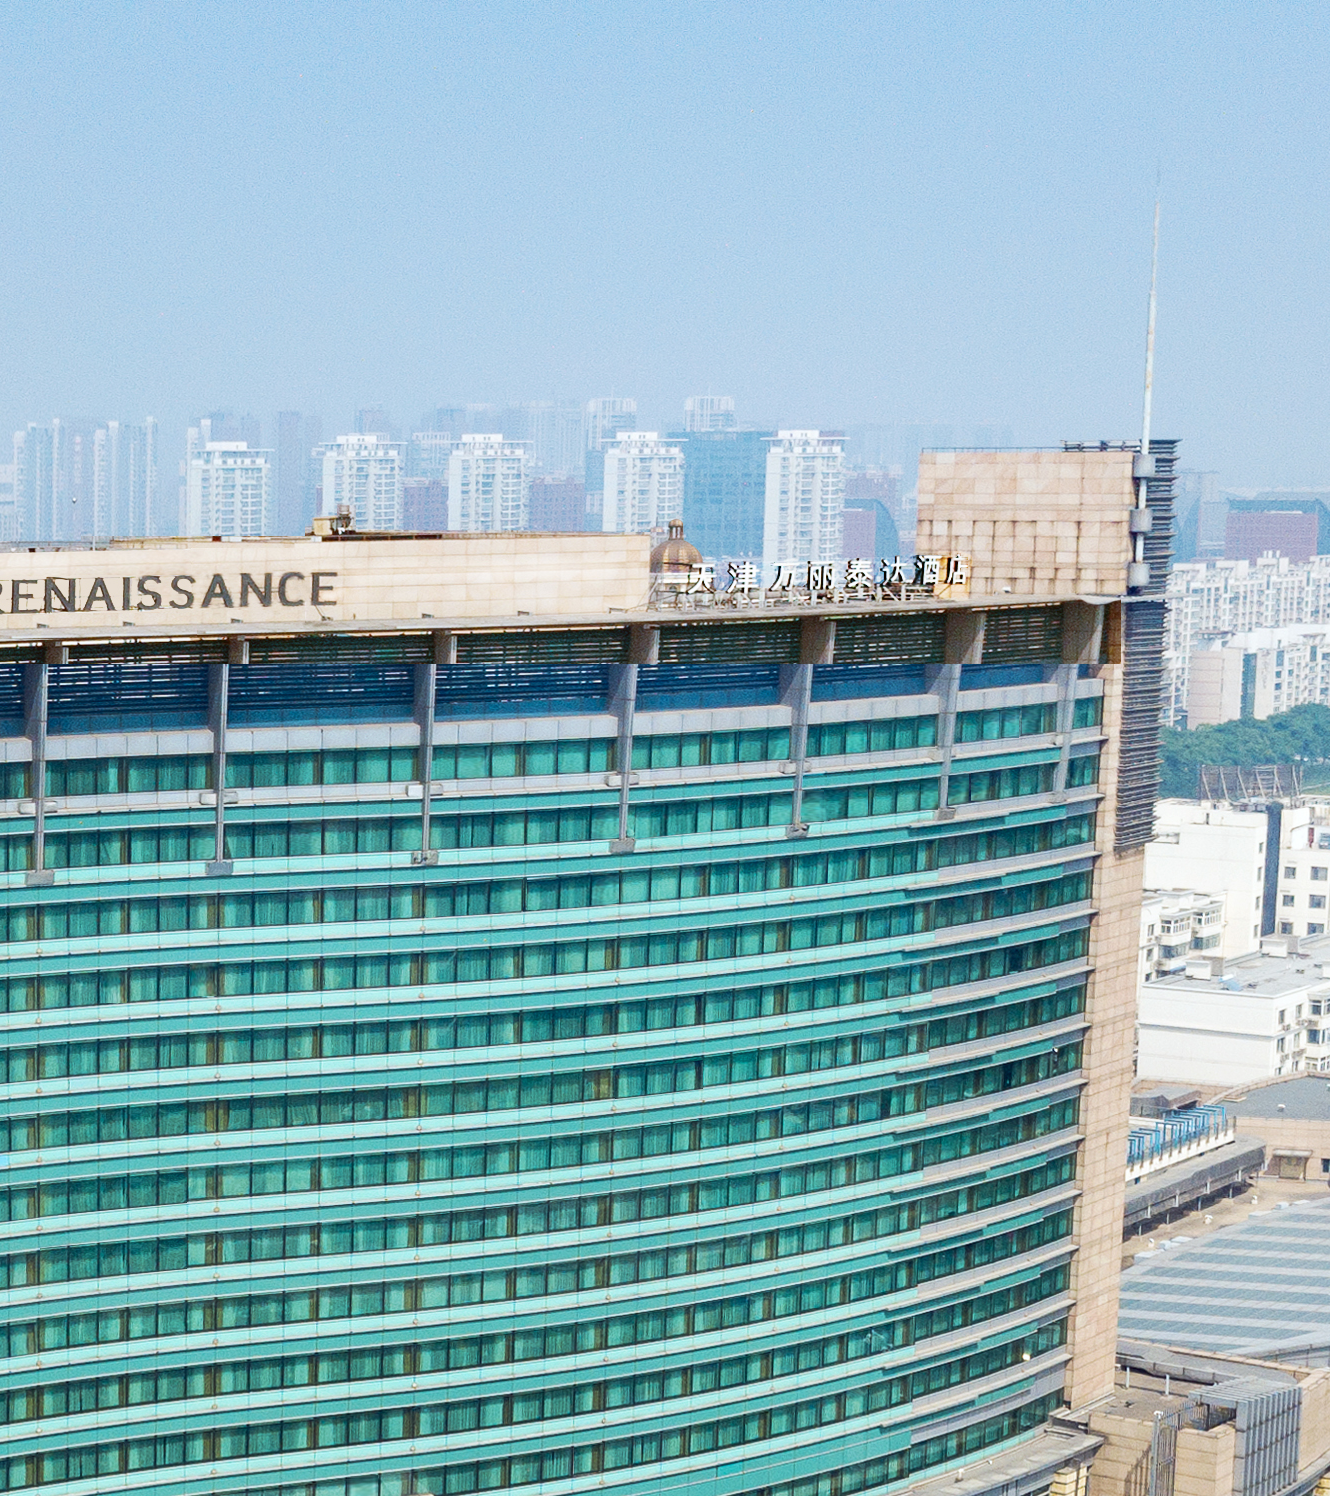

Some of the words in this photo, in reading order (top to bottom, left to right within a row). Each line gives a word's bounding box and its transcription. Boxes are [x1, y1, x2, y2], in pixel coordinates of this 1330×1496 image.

[687, 554, 968, 594] 天津万丽泰达酒店
